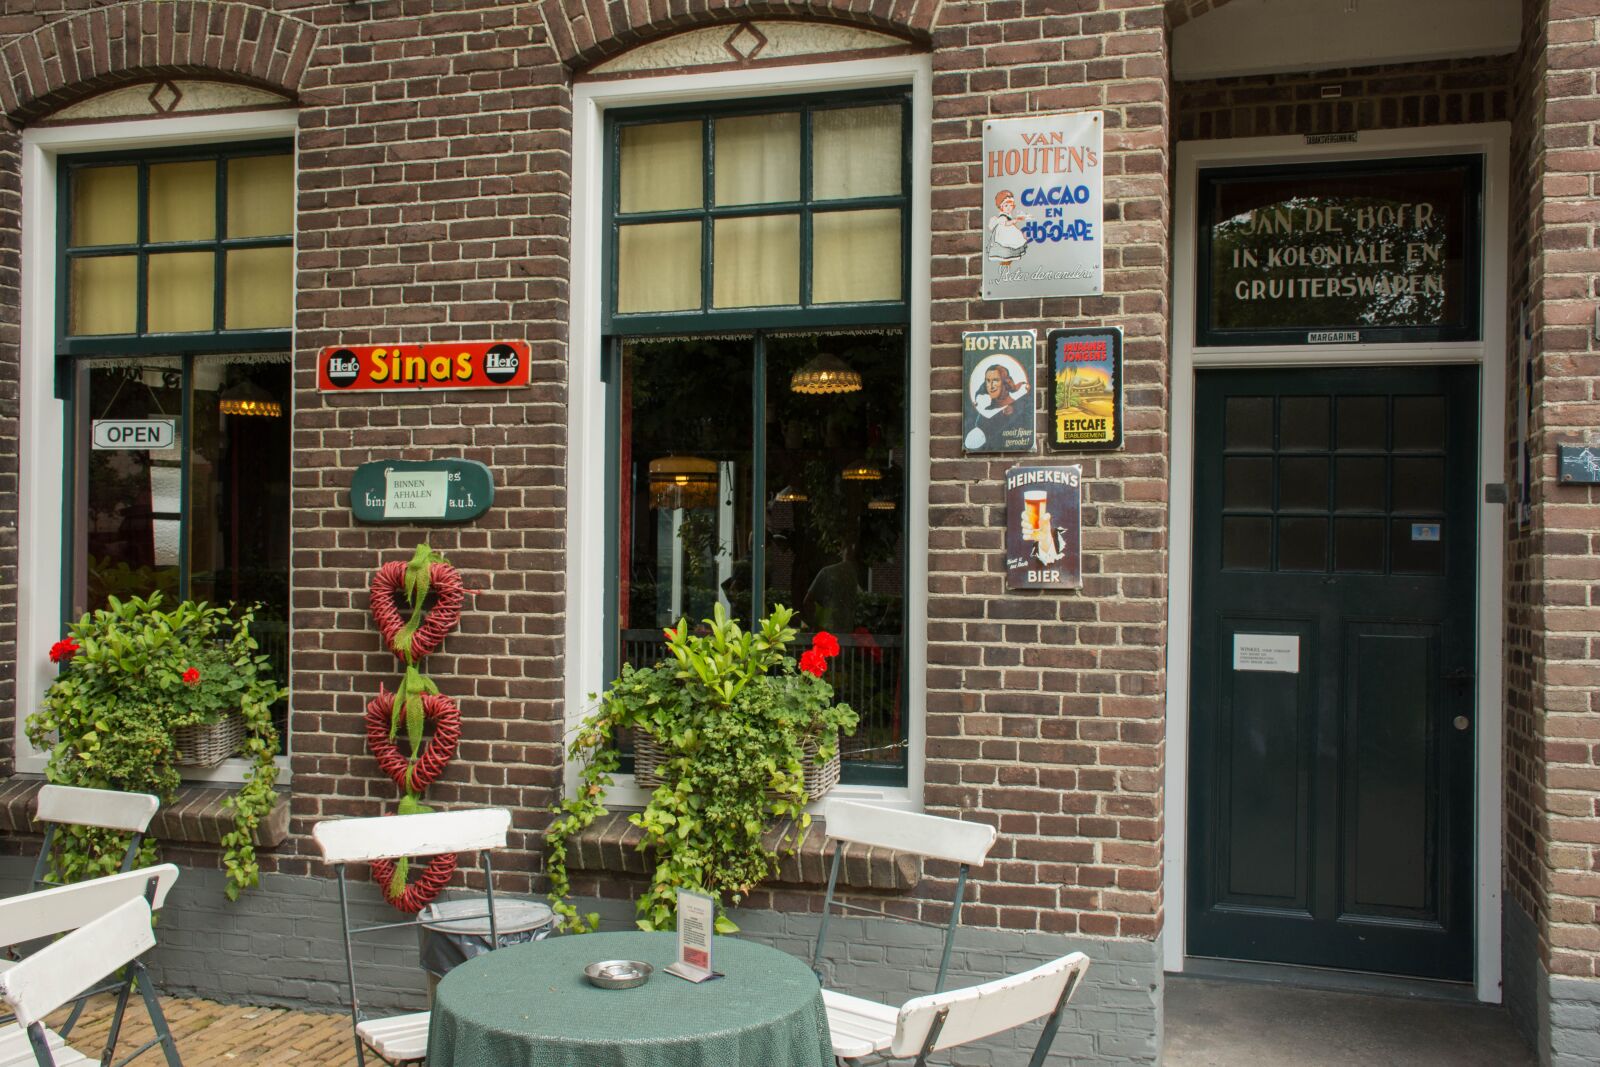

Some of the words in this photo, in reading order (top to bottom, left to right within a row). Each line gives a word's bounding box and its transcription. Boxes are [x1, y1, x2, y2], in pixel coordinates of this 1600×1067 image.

[1020, 131, 1064, 146] VAN
[1020, 184, 1090, 207] CACAO
[1045, 207, 1063, 218] EN
[1240, 206, 1293, 236] JAN
[1305, 205, 1343, 233] DE
[1020, 218, 1094, 244] CHOCOLADE
[1233, 248, 1258, 268] IN
[1268, 243, 1395, 267] KOLONIALE
[1406, 242, 1440, 262] EN
[1031, 264, 1052, 281] dan
[1235, 274, 1444, 300] GRUITERSWAREN
[964, 335, 1033, 351] HOFNAR
[1310, 332, 1358, 343] MARGARINE
[329, 357, 360, 373] Hero
[369, 348, 474, 382] Sinas
[486, 352, 519, 369] Hero
[1063, 418, 1106, 431] EETCAFE
[107, 426, 160, 443] OPEN
[393, 479, 425, 489] BINNEN
[1007, 470, 1079, 491] HEINEKEN'S
[393, 489, 432, 499] AFHALEN
[449, 493, 477, 508] a.u.b.
[393, 501, 417, 510] A.U.B.
[1027, 570, 1060, 583] BIER
